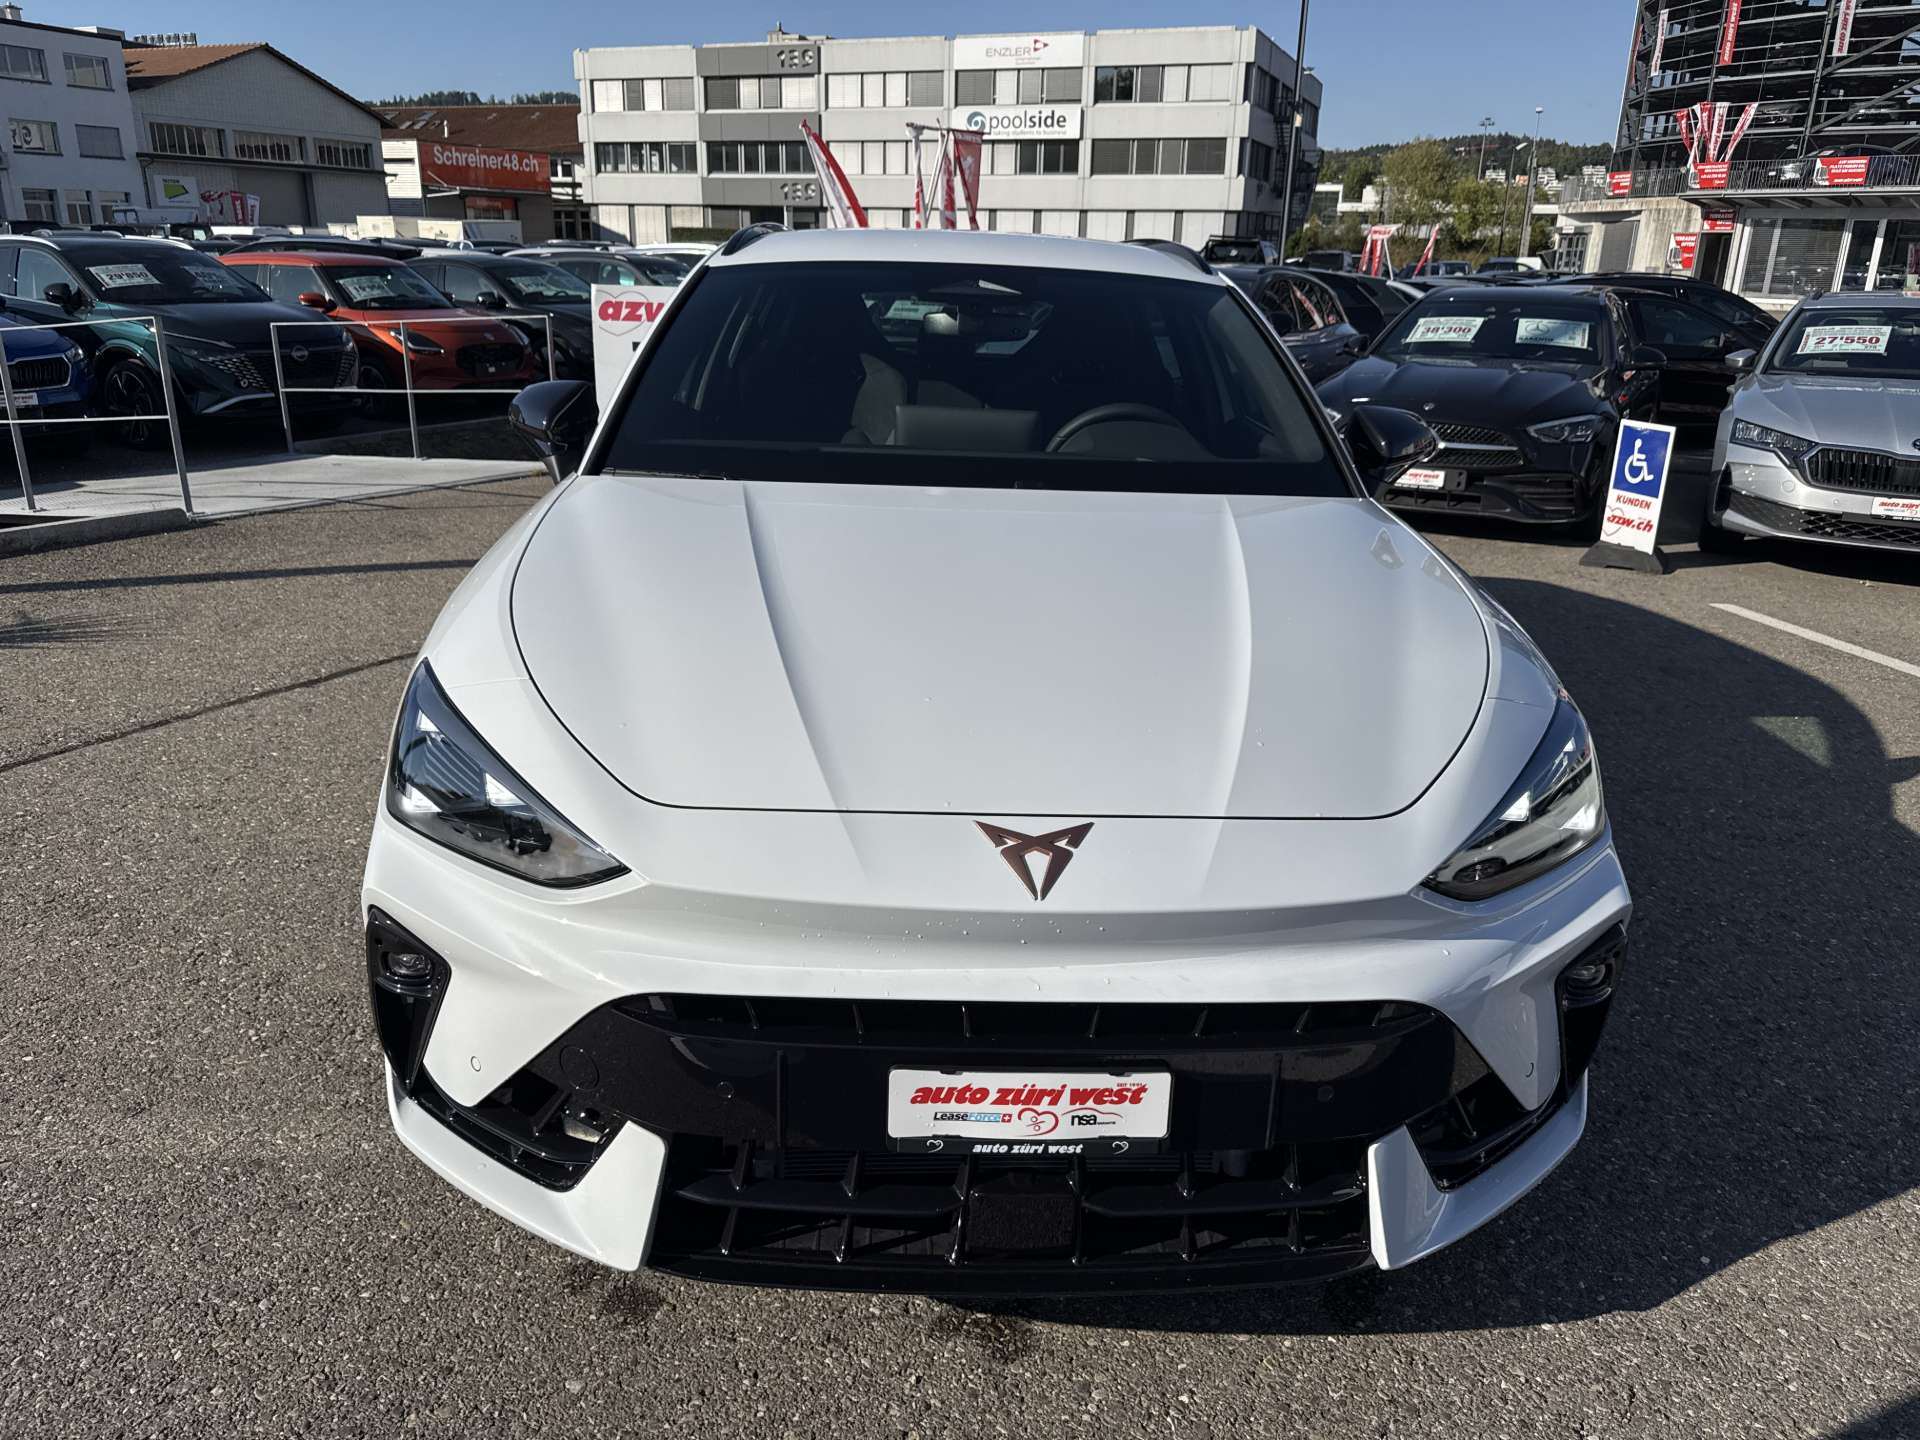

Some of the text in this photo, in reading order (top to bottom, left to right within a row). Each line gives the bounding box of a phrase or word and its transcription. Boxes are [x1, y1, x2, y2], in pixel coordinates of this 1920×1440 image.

[777, 49, 814, 68] 139
[985, 47, 1032, 58] ENZLER
[990, 109, 1067, 131] poolside
[434, 146, 539, 172] Schreiner48.ch
[780, 183, 816, 201] 139
[1814, 336, 1881, 345] 27'550
[1616, 494, 1652, 510] KUNDEN
[1607, 514, 1653, 533] azw.ch
[910, 1083, 1148, 1106] auto züri west
[933, 1112, 1001, 1122] LeaseForce
[1071, 1114, 1097, 1126] nsa
[972, 1143, 1083, 1154] auto züri west
